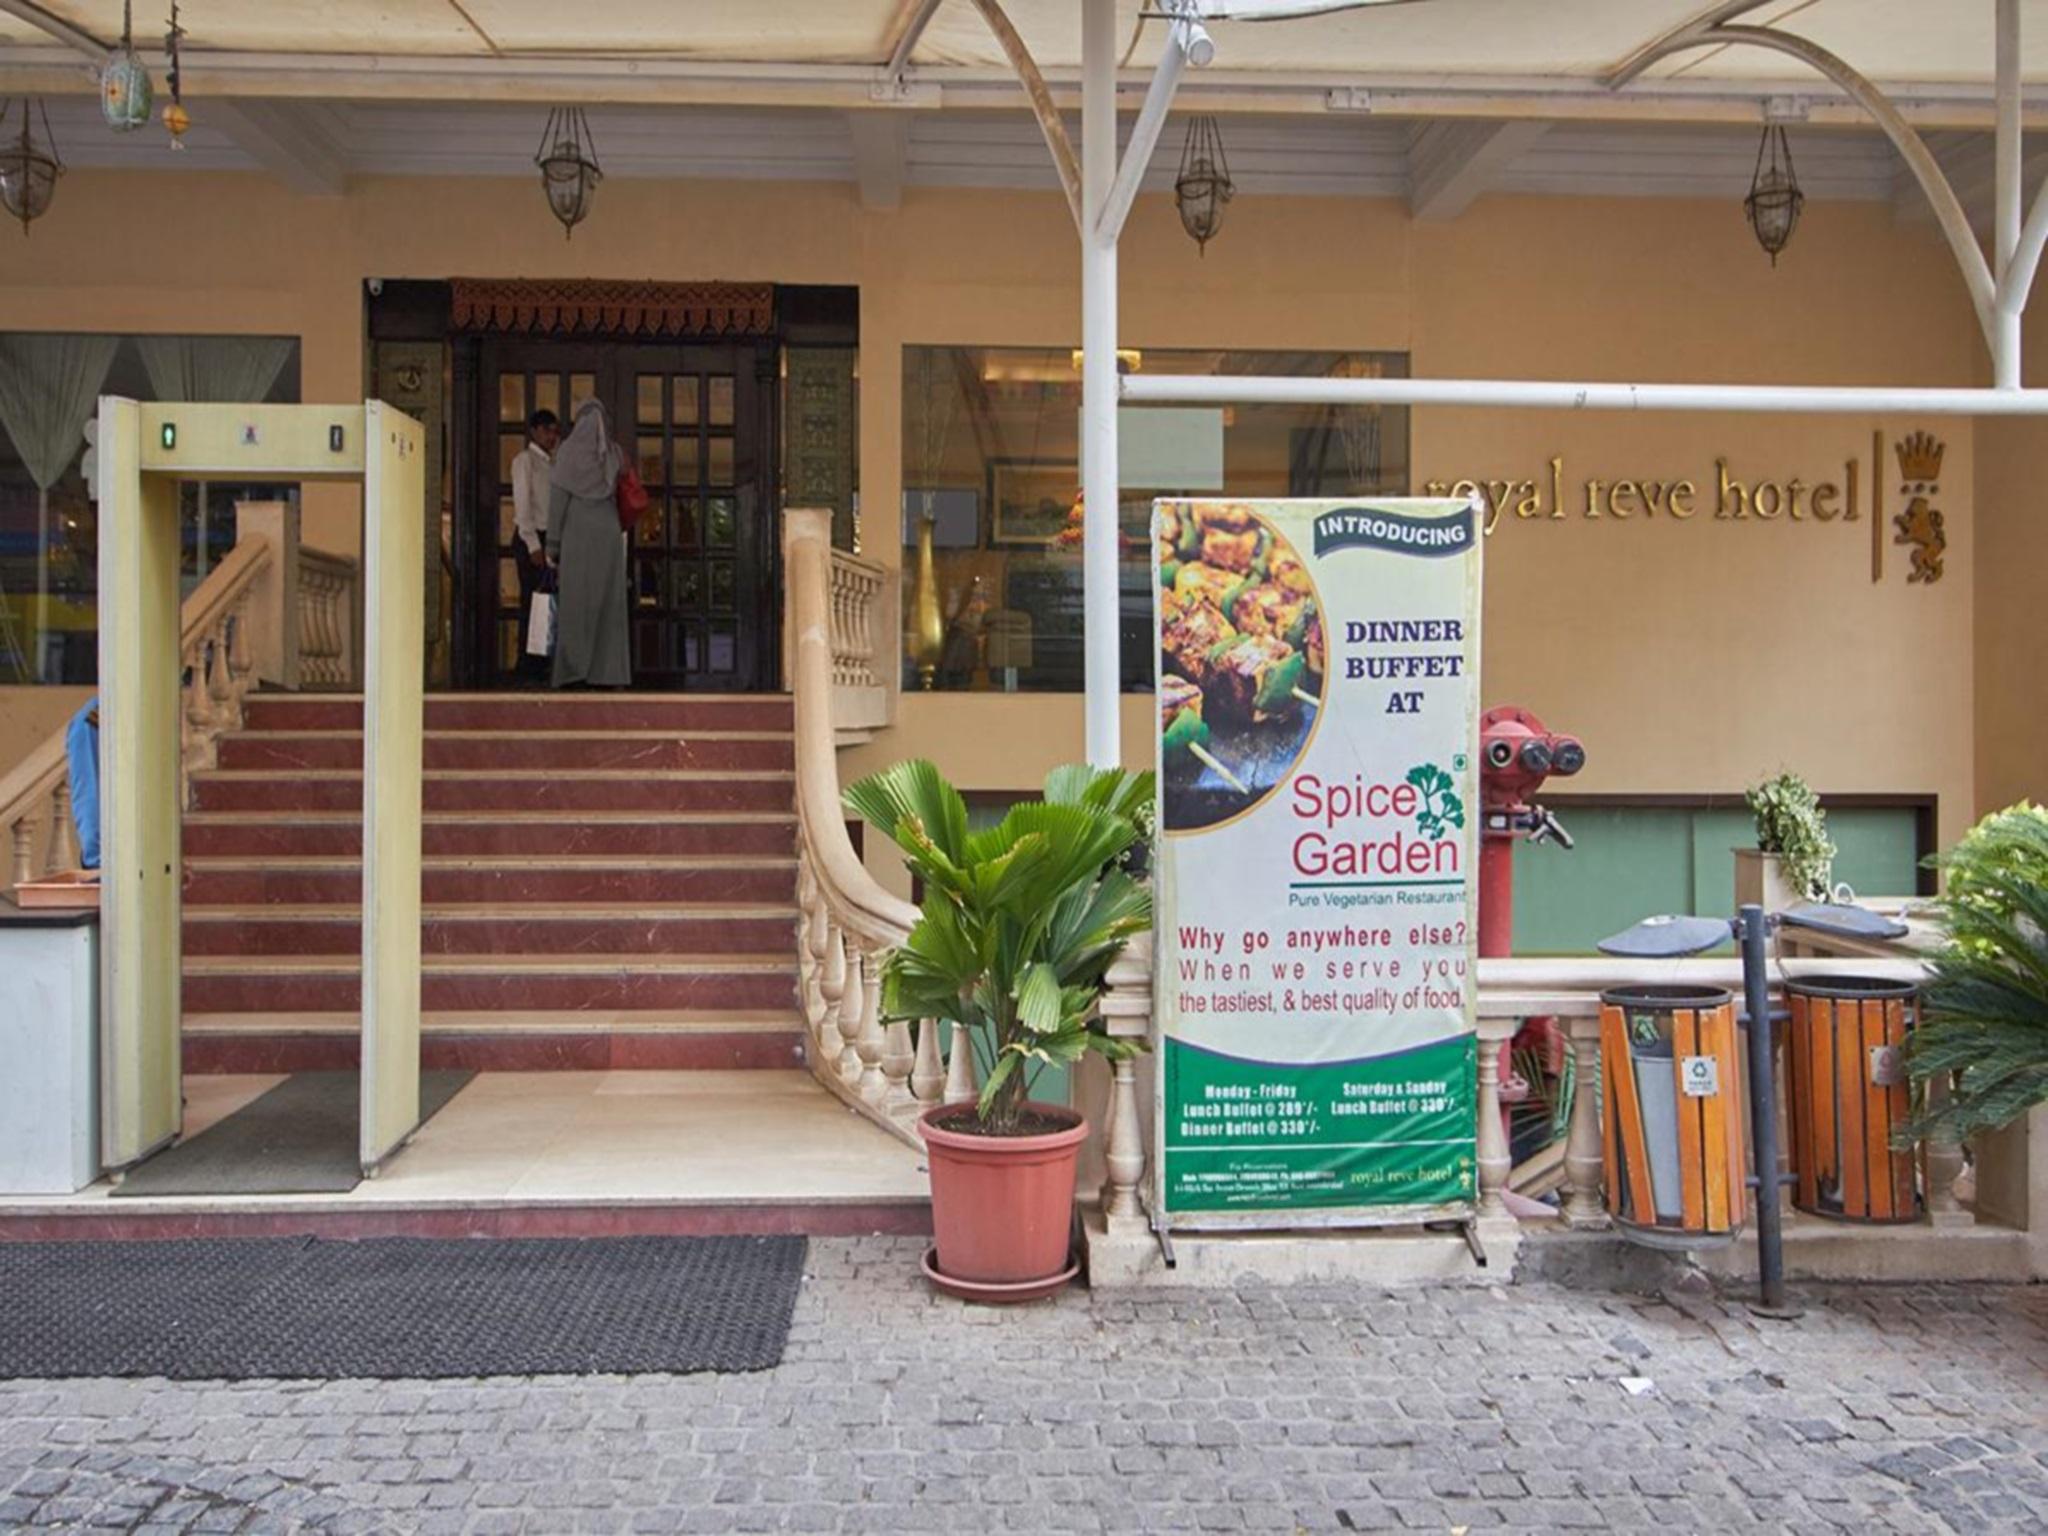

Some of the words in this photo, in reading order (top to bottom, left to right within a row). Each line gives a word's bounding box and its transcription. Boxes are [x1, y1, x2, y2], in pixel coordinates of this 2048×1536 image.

[1583, 478, 1698, 521] reve
[1715, 456, 1862, 521] hotel
[1317, 516, 1467, 546] INTRODUCING
[1345, 619, 1464, 643] DINNER
[1345, 655, 1464, 679] BUFFET
[1385, 691, 1424, 714] AT
[1292, 773, 1417, 829] Spice
[1292, 830, 1458, 876] Garden
[1288, 892, 1320, 907] Pure
[1323, 891, 1393, 909] Vegetarian
[1396, 889, 1466, 905] Restaurant
[1179, 926, 1225, 955] Why
[1242, 930, 1270, 954] go
[1286, 924, 1392, 952] anywhere
[1408, 921, 1467, 945] else?
[1178, 958, 1251, 982] When
[1272, 962, 1304, 981] we
[1325, 959, 1401, 980] serve
[1421, 957, 1467, 982] you
[1178, 990, 1207, 1013] the
[1211, 989, 1278, 1014] tastiest,
[1282, 988, 1296, 1011] &
[1301, 988, 1338, 1011] best
[1341, 986, 1398, 1015] quality
[1402, 985, 1420, 1009] of
[1422, 984, 1467, 1009] food.
[1205, 1084, 1251, 1100] Monday
[1259, 1083, 1297, 1099] Friday
[1342, 1081, 1394, 1097] Saturday
[1405, 1080, 1447, 1096] Sunday
[1183, 1102, 1220, 1118] Lunch
[1223, 1102, 1263, 1117] Buffet
[1330, 1100, 1367, 1115] Lunch
[1369, 1099, 1406, 1115] Buffet
[1181, 1121, 1223, 1137] Dinner
[1225, 1121, 1265, 1136] Buffet
[1350, 1165, 1384, 1188] royal
[1418, 1163, 1453, 1182] hotel
